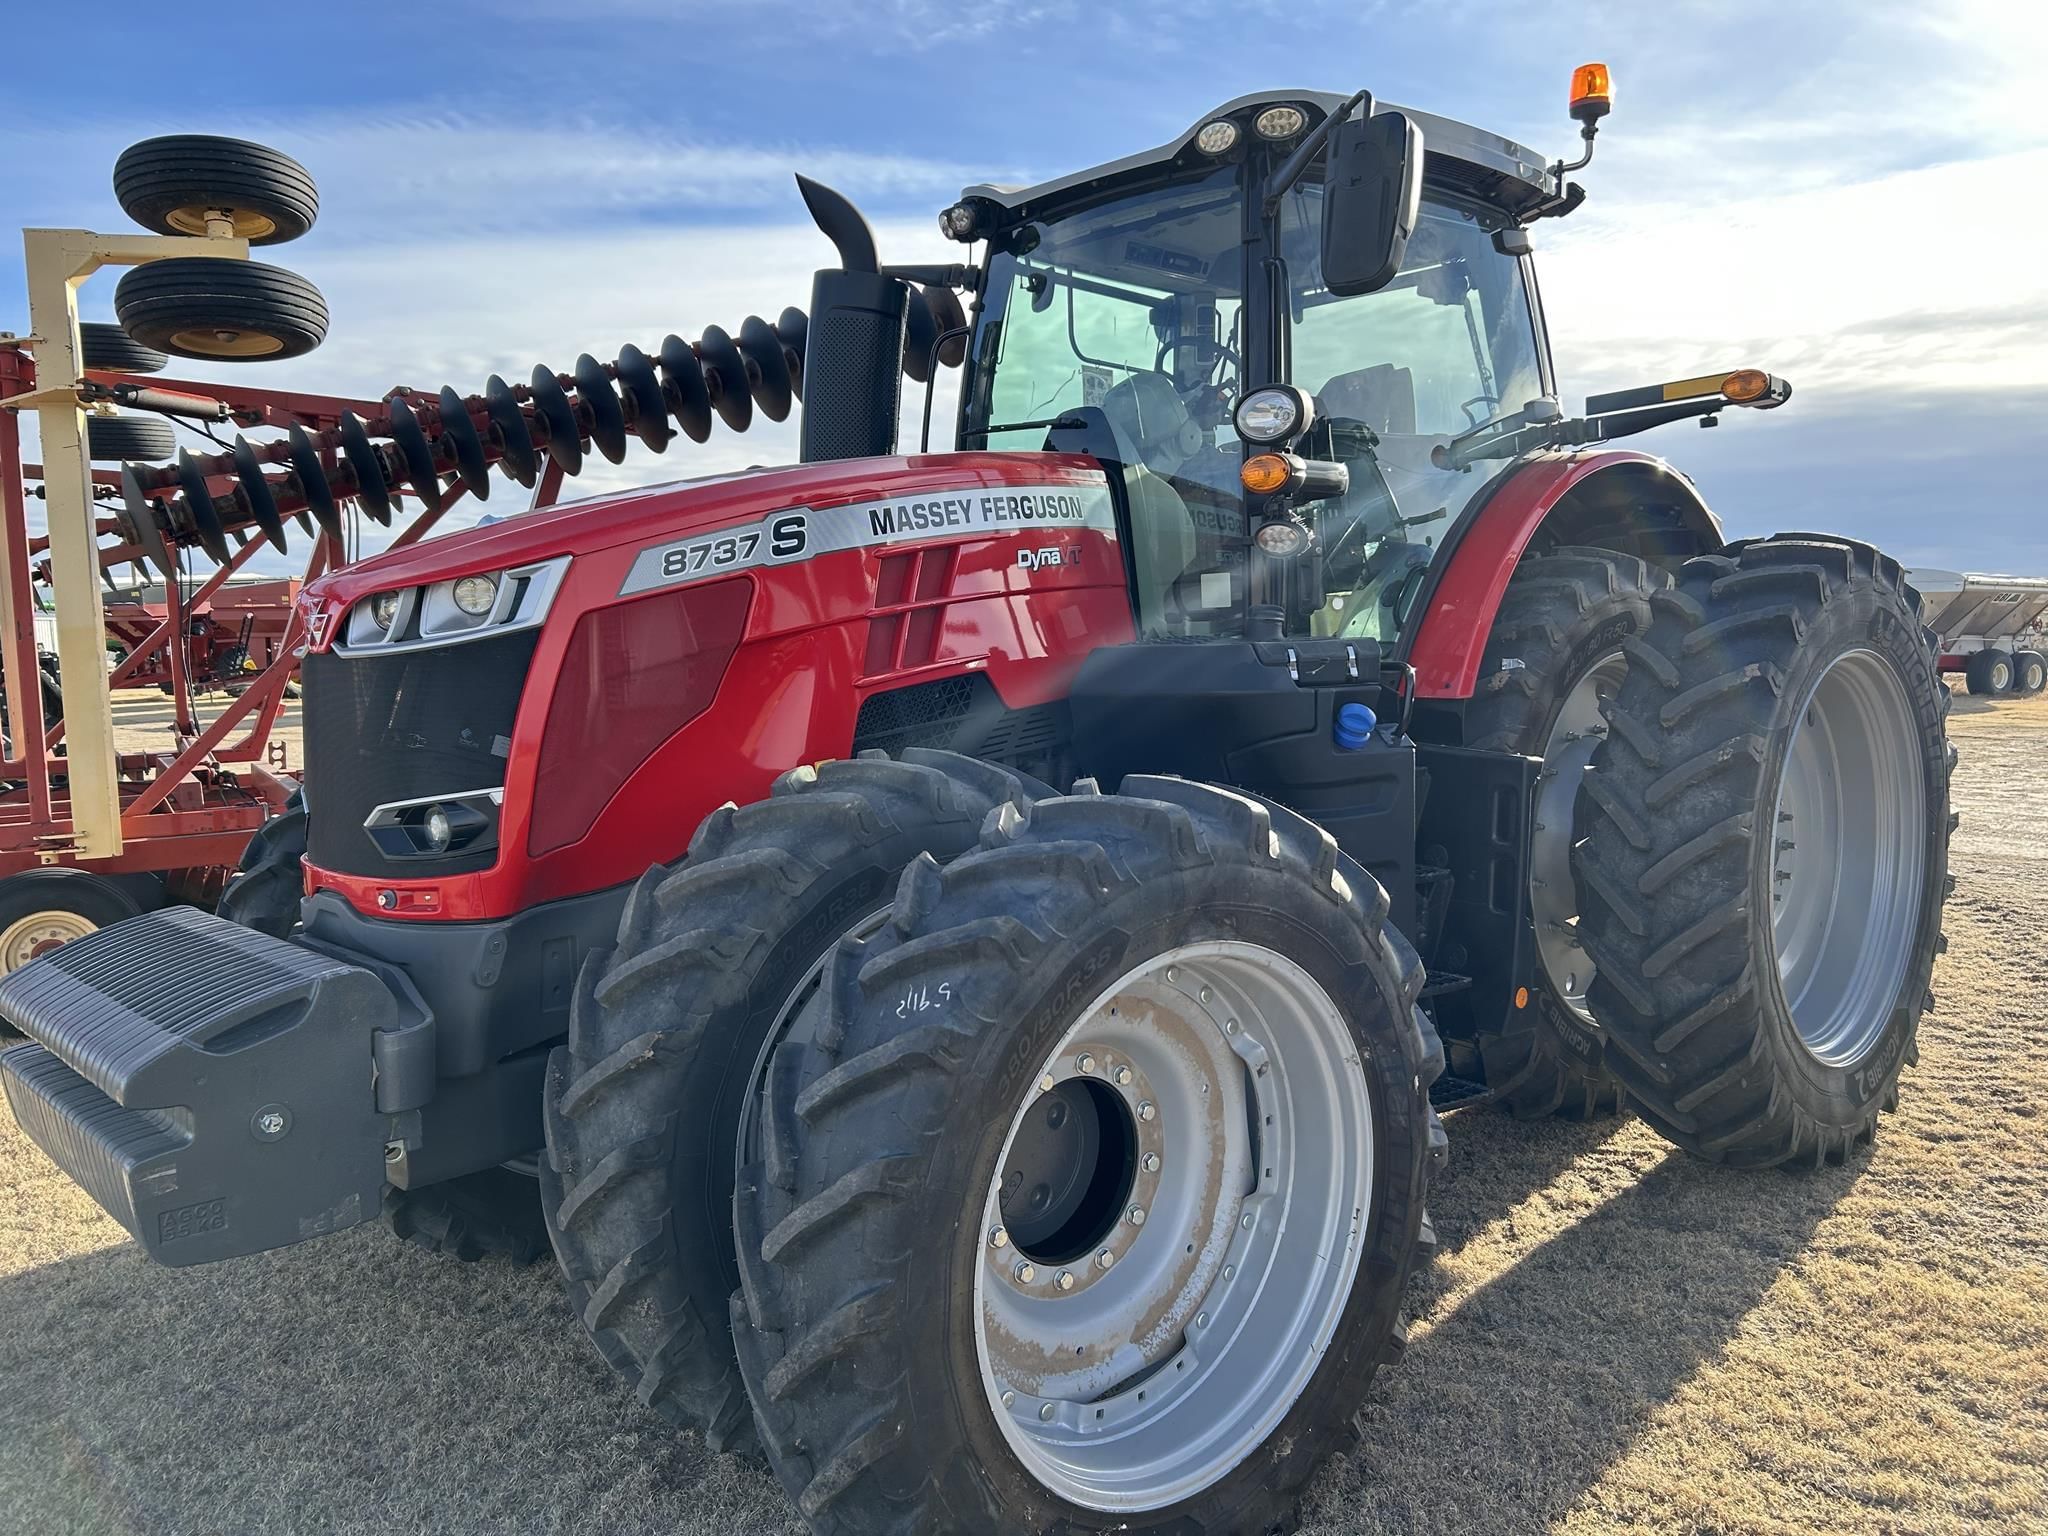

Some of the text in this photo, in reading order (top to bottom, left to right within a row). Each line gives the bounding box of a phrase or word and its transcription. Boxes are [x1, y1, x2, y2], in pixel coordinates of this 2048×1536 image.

[868, 495, 1083, 536] MASSEY FERGUSON
[661, 514, 807, 578] 8737 S
[1017, 545, 1082, 572] DynaVT
[162, 1200, 223, 1227] AGCO
[195, 1214, 226, 1234] KG
